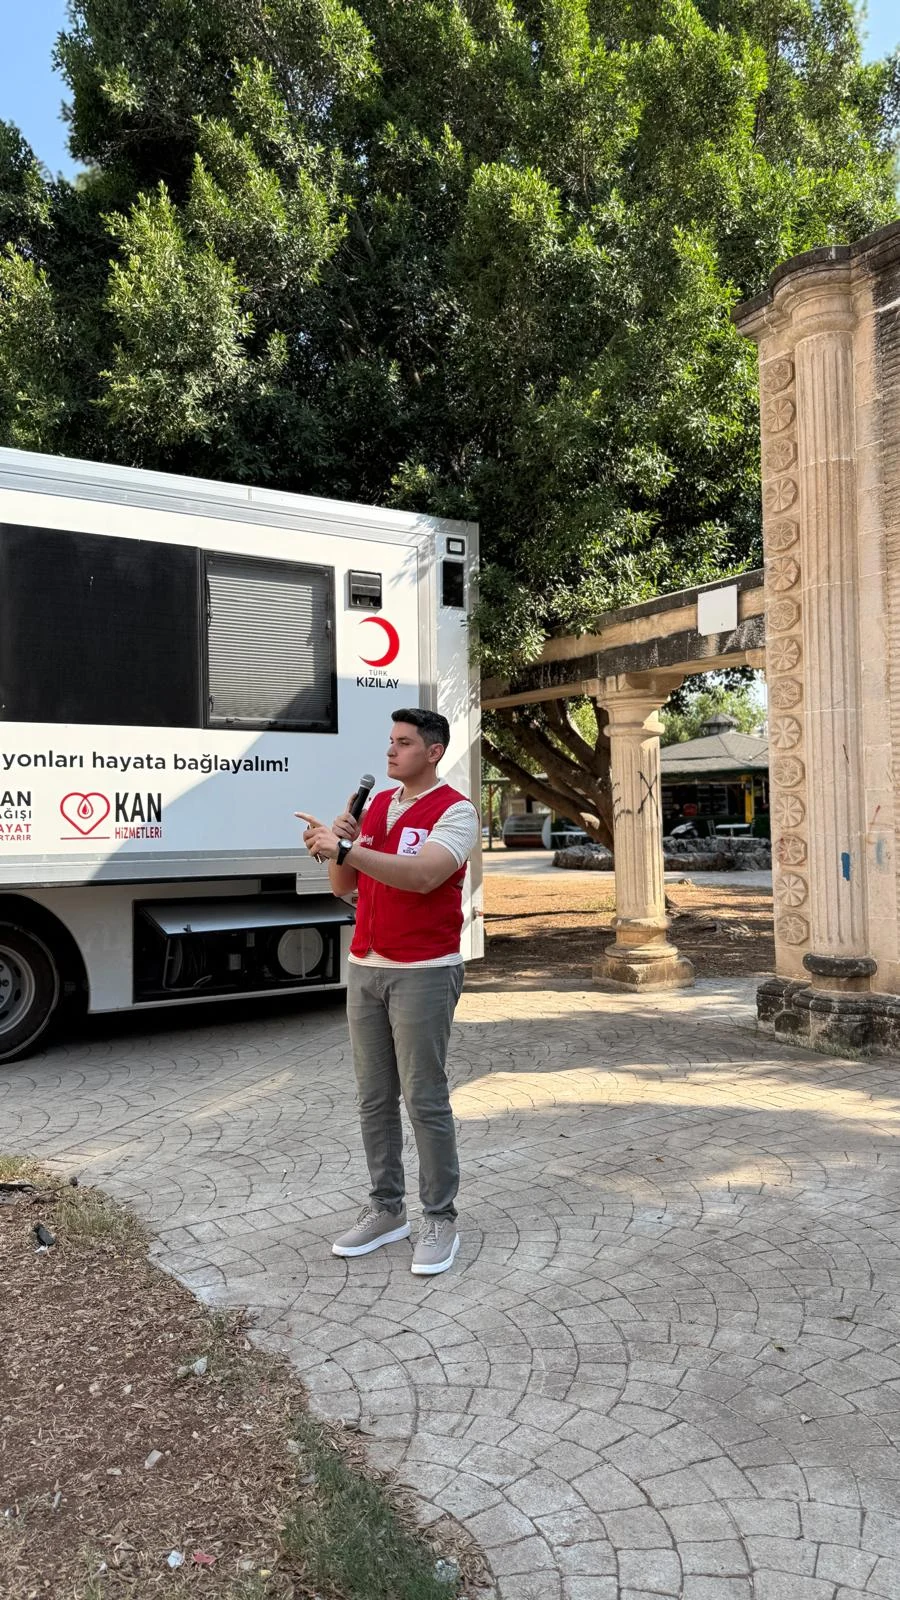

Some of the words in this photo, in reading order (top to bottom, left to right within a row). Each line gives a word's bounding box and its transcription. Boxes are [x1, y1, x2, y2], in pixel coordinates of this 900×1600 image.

[356, 676, 399, 689] KIZILAY
[2, 750, 84, 770] yonları
[92, 751, 166, 772] hayata
[174, 753, 289, 774] bağlayalım!
[0, 807, 31, 821] ĞIŞI
[115, 792, 162, 822] KAN
